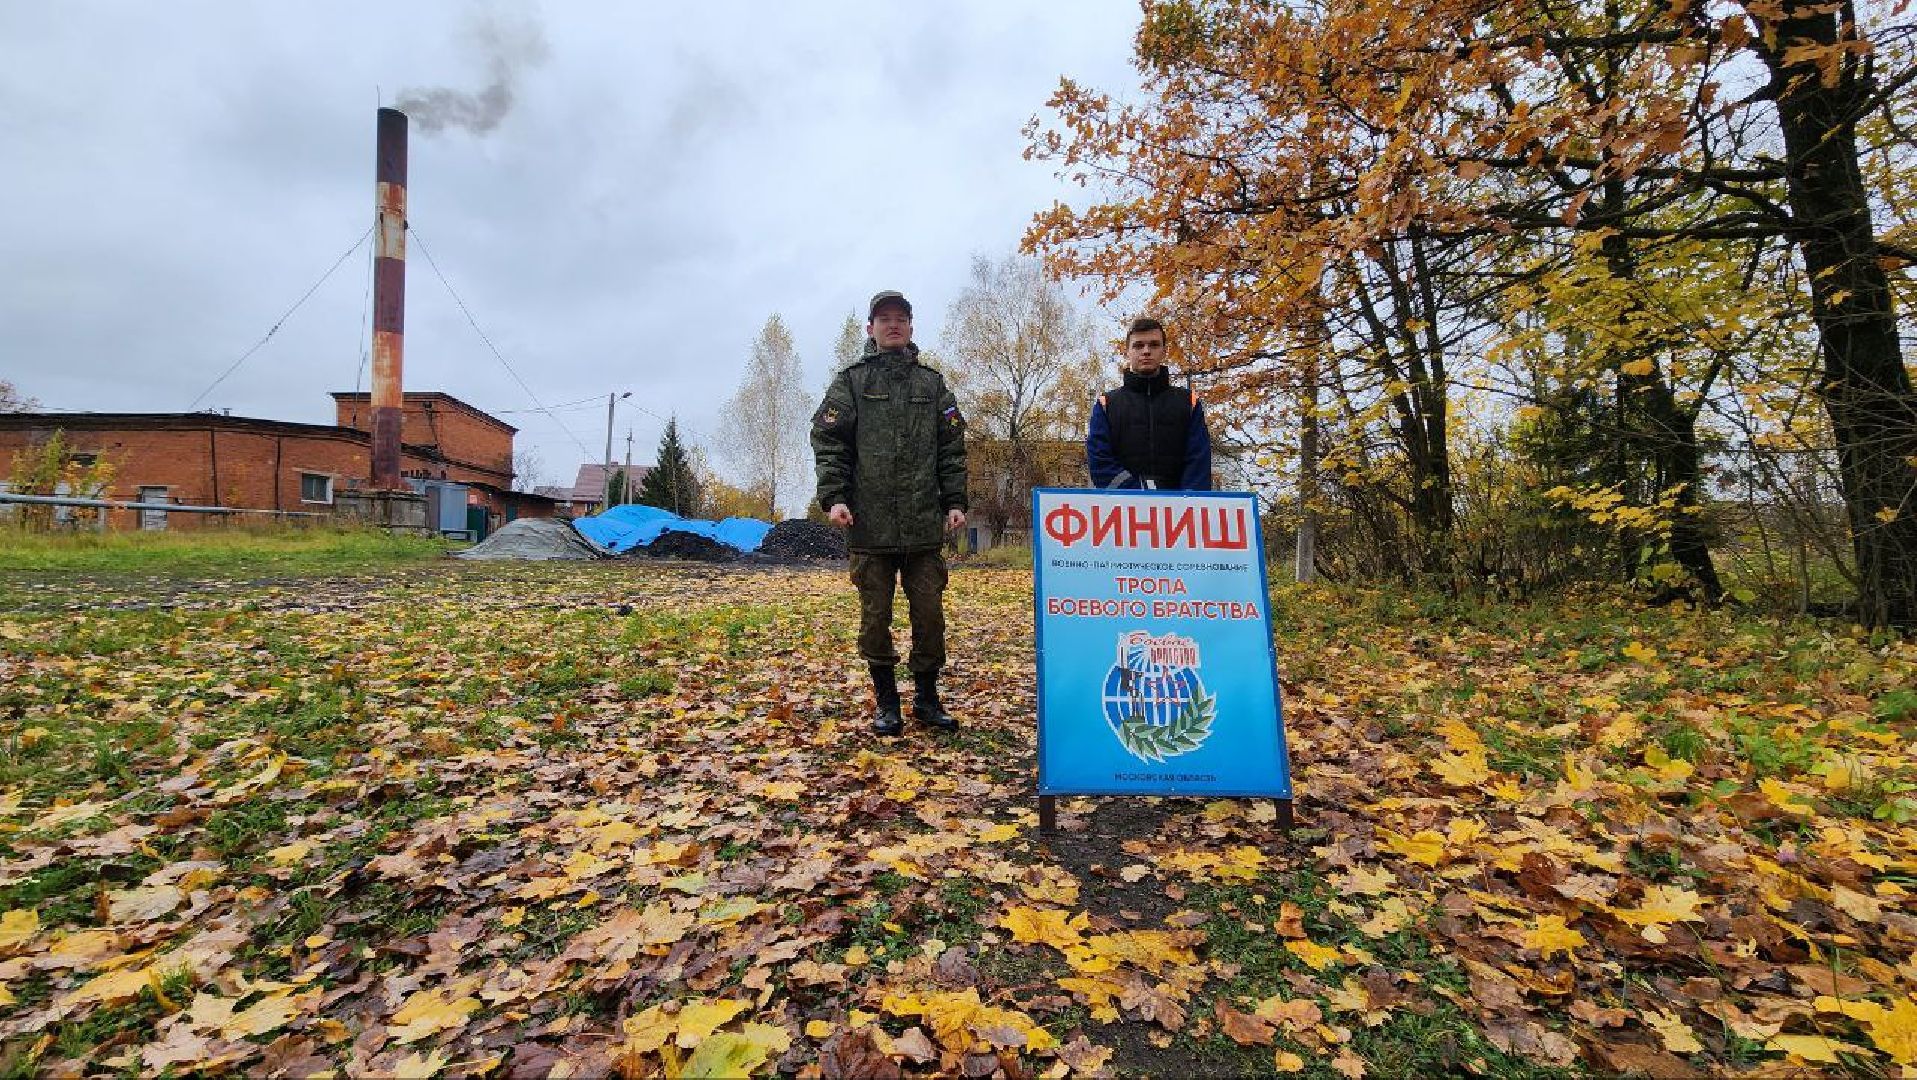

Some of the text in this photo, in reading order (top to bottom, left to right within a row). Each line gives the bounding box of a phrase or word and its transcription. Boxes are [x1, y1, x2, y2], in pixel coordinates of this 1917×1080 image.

[1044, 503, 1248, 550] ФИНИШ
[1115, 577, 1187, 595] ТРОПА
[1048, 598, 1260, 619] БОЕВОГО БРАТСТВА
